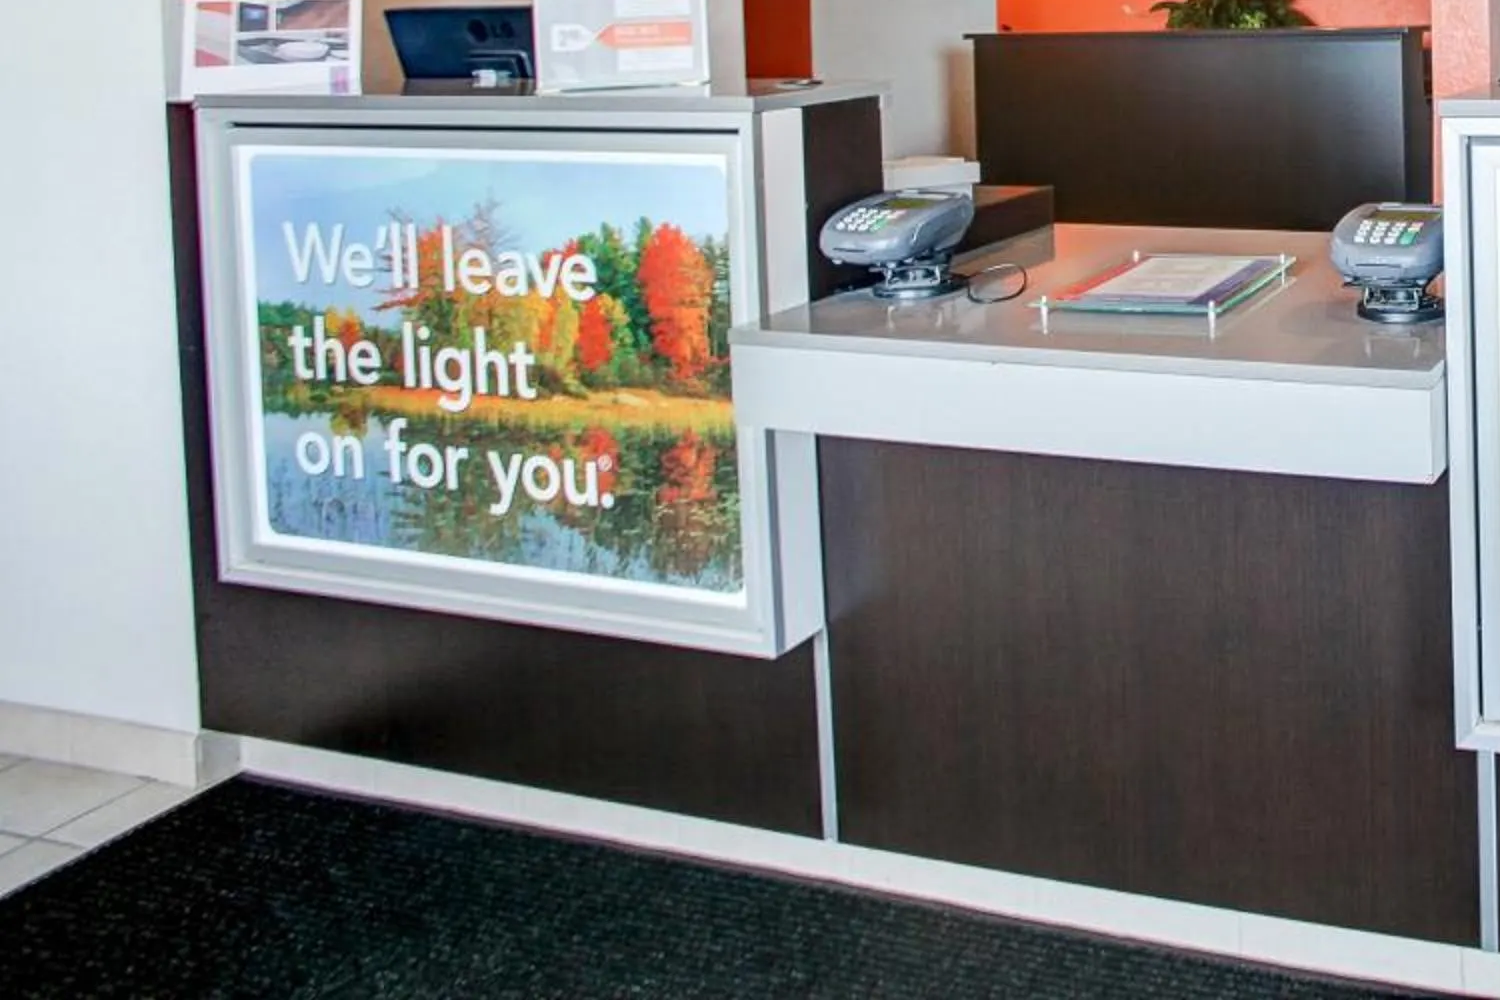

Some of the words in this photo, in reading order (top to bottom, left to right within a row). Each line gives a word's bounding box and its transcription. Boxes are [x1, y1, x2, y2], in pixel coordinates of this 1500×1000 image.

[283, 220, 419, 290] We'll
[442, 224, 597, 301] leave
[288, 315, 381, 385] the
[402, 321, 537, 412] light
[295, 430, 364, 480] on
[384, 418, 468, 491] for
